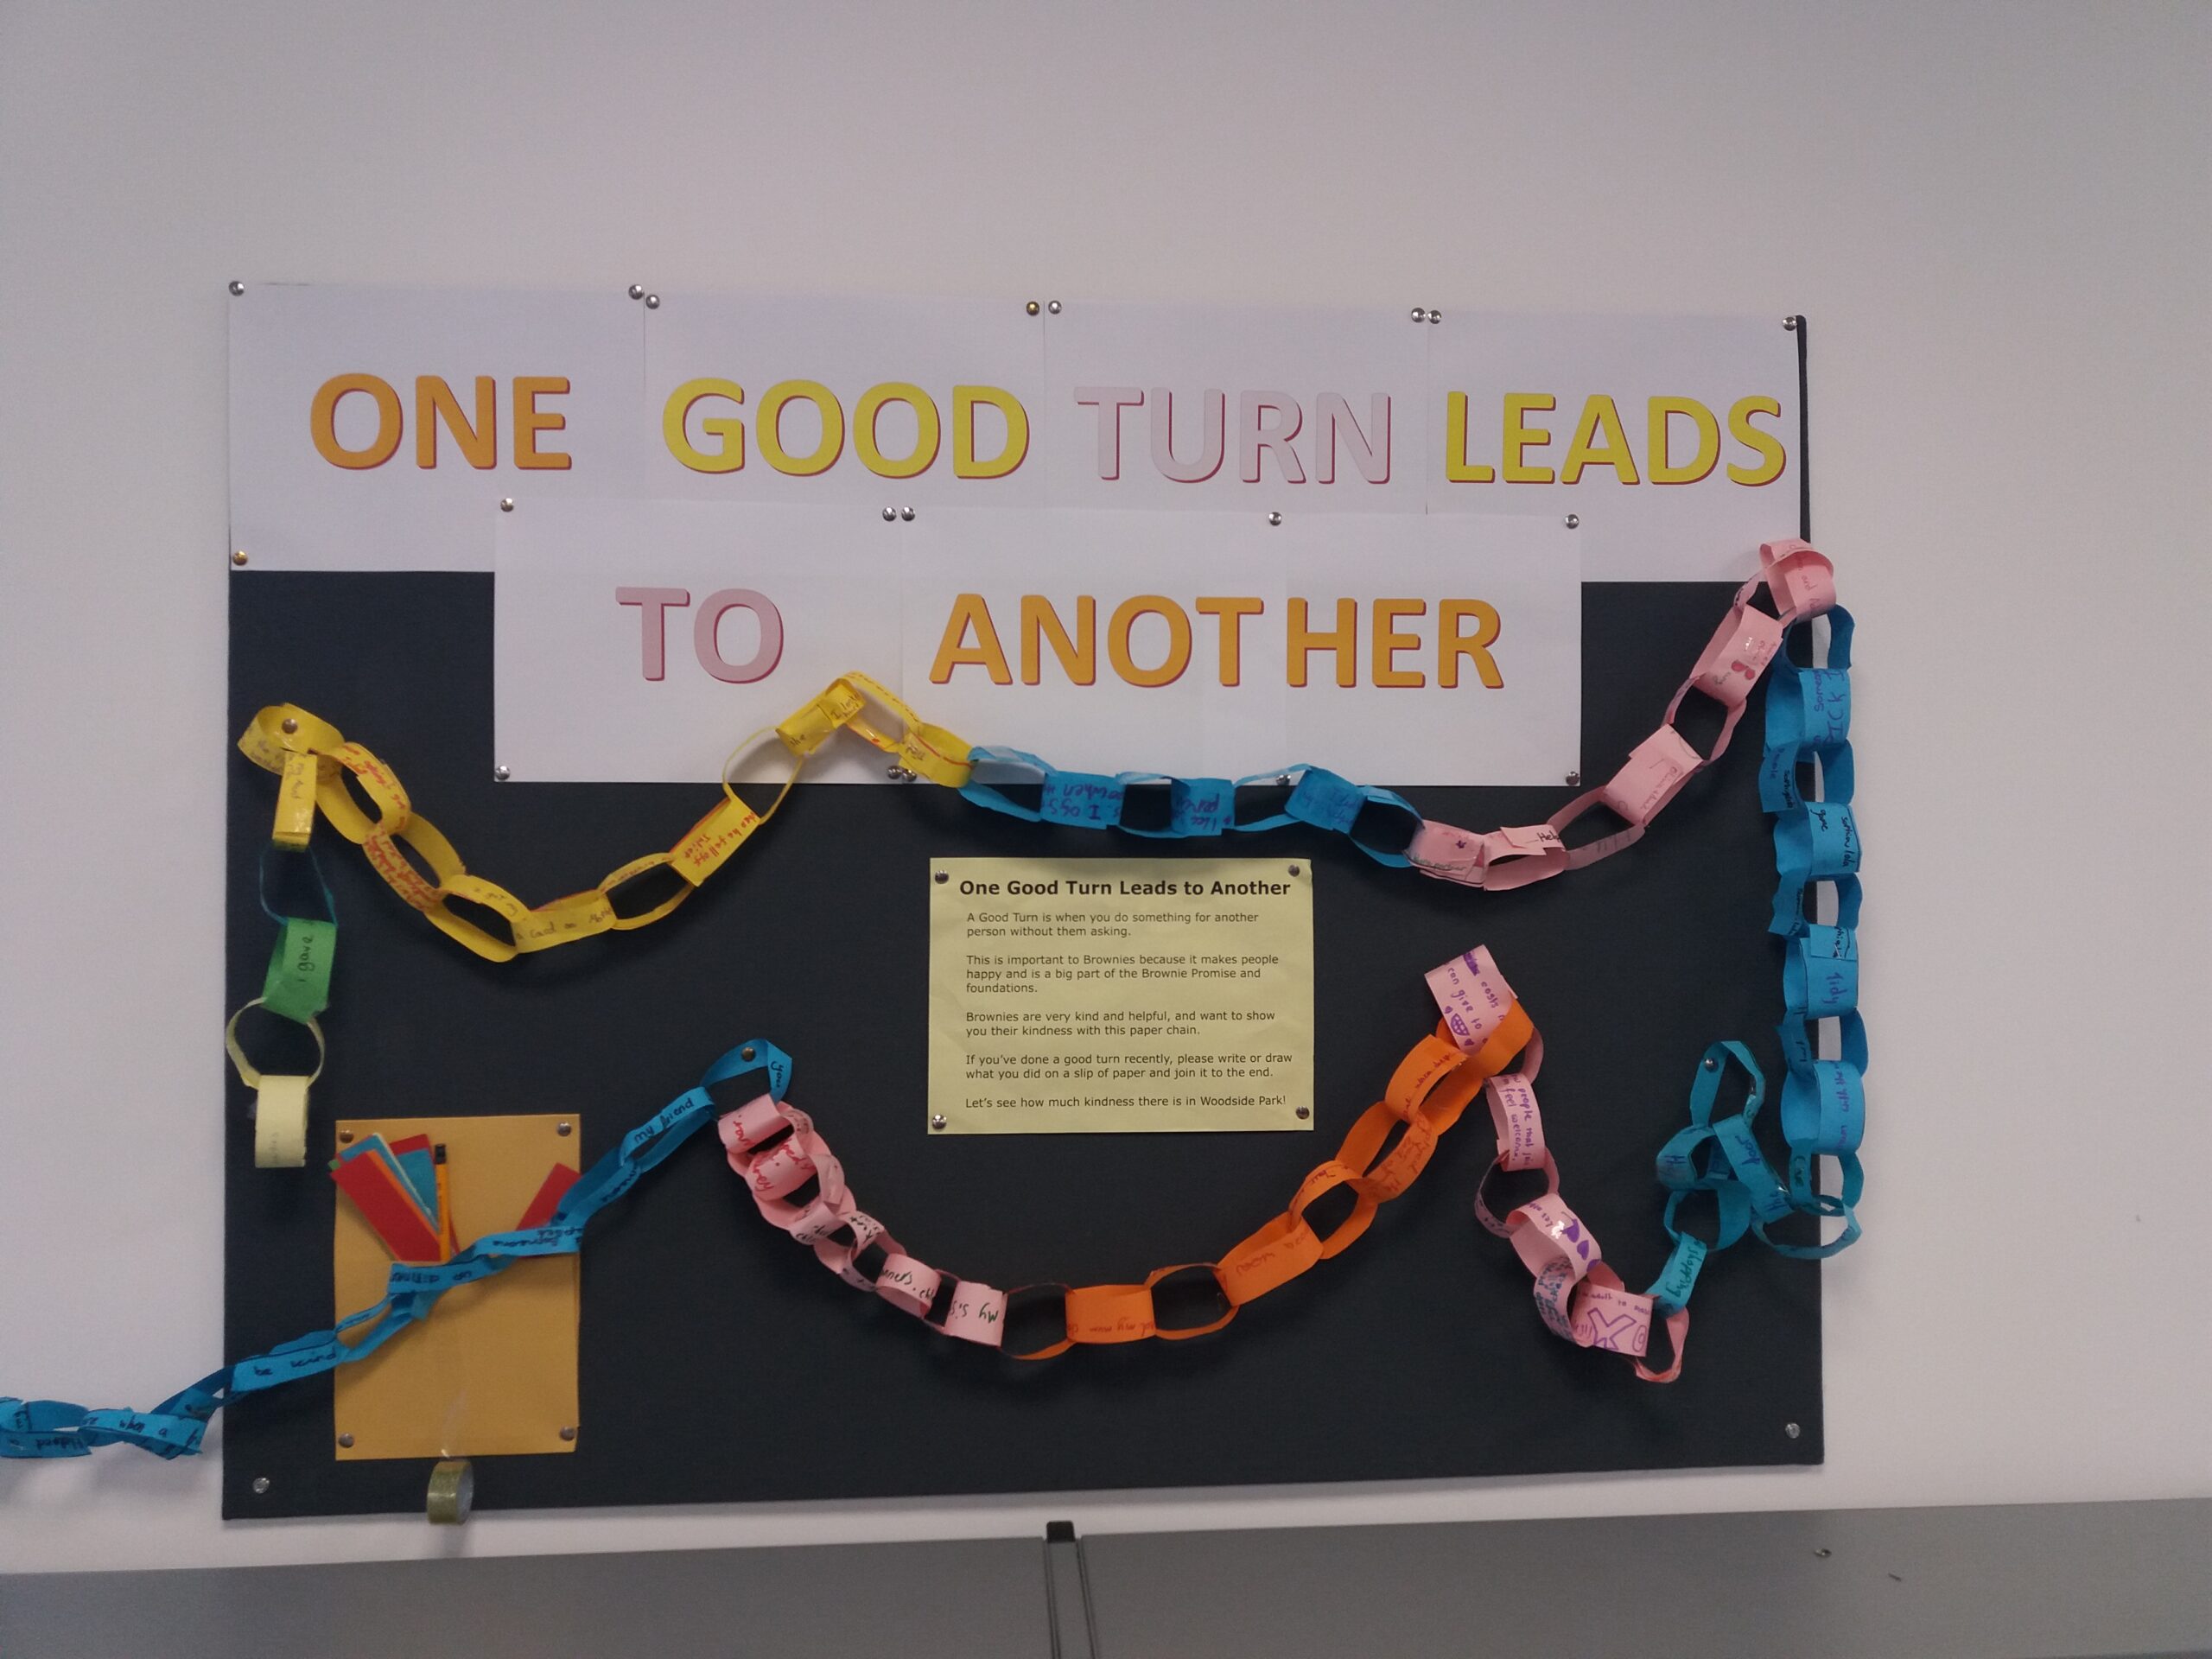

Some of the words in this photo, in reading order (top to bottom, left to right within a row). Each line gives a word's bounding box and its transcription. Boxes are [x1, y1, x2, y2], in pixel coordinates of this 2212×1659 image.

[310, 373, 572, 471] ONE
[663, 378, 1030, 480] GOOD
[1075, 387, 1391, 485] TURN
[1445, 391, 1787, 487] LEADS
[617, 588, 784, 684] TO
[928, 592, 1504, 690] ANOTHER
[960, 880, 1000, 895] One
[1007, 880, 1058, 895] Good
[1065, 880, 1111, 894] Turn
[1120, 880, 1177, 895] Leads
[1184, 881, 1204, 895] to
[1211, 880, 1291, 895] Another
[967, 912, 975, 922] A
[979, 912, 1008, 922] Good
[1012, 912, 1038, 922] Turn
[1043, 913, 1052, 922] is
[1056, 912, 1085, 922] when
[1090, 914, 1110, 924] you
[1115, 912, 1128, 922] do
[1133, 912, 1191, 924] something
[1196, 912, 1211, 922] for
[1215, 912, 1259, 922] another
[967, 929, 1006, 938] person
[1010, 926, 1053, 936] without
[1057, 926, 1086, 936] them
[1090, 926, 1131, 938] asking.
[966, 956, 990, 964] This
[995, 956, 1003, 964] is
[1007, 956, 1064, 966] important
[1068, 956, 1079, 964] to
[1084, 955, 1135, 964] Brownies
[1140, 955, 1185, 964] because
[1190, 955, 1197, 964] it
[1201, 955, 1237, 963] makes
[1242, 955, 1279, 966] people
[967, 969, 1001, 981] happy
[1006, 969, 1027, 978] and
[1032, 969, 1040, 978] is
[1056, 969, 1072, 981] big
[1077, 969, 1100, 980] part
[1104, 969, 1116, 978] of
[1119, 969, 1137, 978] the
[1142, 969, 1187, 978] Brownie
[1192, 969, 1236, 978] Promise
[1240, 966, 1261, 977] and
[966, 982, 1037, 993] foundations.
[966, 1012, 1019, 1021] Brownies
[1046, 1014, 1071, 1023] very
[1075, 1011, 1098, 1020] kind
[1103, 1011, 1124, 1020] and
[1128, 1011, 1170, 1022] helpful,
[1175, 1011, 1195, 1020] and
[1200, 1011, 1229, 1020] want
[1231, 1011, 1243, 1020] to
[1247, 1010, 1274, 1020] show
[966, 1028, 987, 1038] you
[991, 1026, 1018, 1036] their
[1022, 1025, 1072, 1035] kindness
[1077, 1026, 1100, 1035] with
[1105, 1026, 1126, 1035] this
[1130, 1027, 1163, 1037] paper
[1166, 1024, 1199, 1034] chain.
[966, 1054, 976, 1065] If
[979, 1054, 1016, 1066] you've
[1020, 1054, 1049, 1065] done
[1065, 1054, 1091, 1066] good
[1096, 1054, 1120, 1064] turn
[1125, 1053, 1173, 1065] recently,
[1178, 1053, 1214, 1065] please
[1218, 1054, 1246, 1063] write
[1266, 1053, 1292, 1062] draw
[966, 1067, 994, 1078] what
[998, 1071, 1019, 1080] you
[1023, 1069, 1040, 1078] did
[1074, 1068, 1093, 1080] slip
[1098, 1068, 1109, 1077] of
[1113, 1070, 1146, 1080] paper
[1149, 1066, 1170, 1077] and
[1173, 1066, 1195, 1079] join
[1200, 1068, 1207, 1077] it
[1211, 1068, 1223, 1077] to
[1227, 1067, 1245, 1077] the
[1249, 1067, 1273, 1077] end.
[966, 1098, 993, 1108] Let's
[1020, 1097, 1044, 1107] how
[1049, 1096, 1079, 1107] much
[1084, 1096, 1135, 1106] kindness
[1139, 1096, 1168, 1106] there
[1173, 1096, 1181, 1106] is
[1186, 1096, 1196, 1105] in
[1200, 1096, 1255, 1106] Woodside
[1259, 1096, 1286, 1105] Park!
